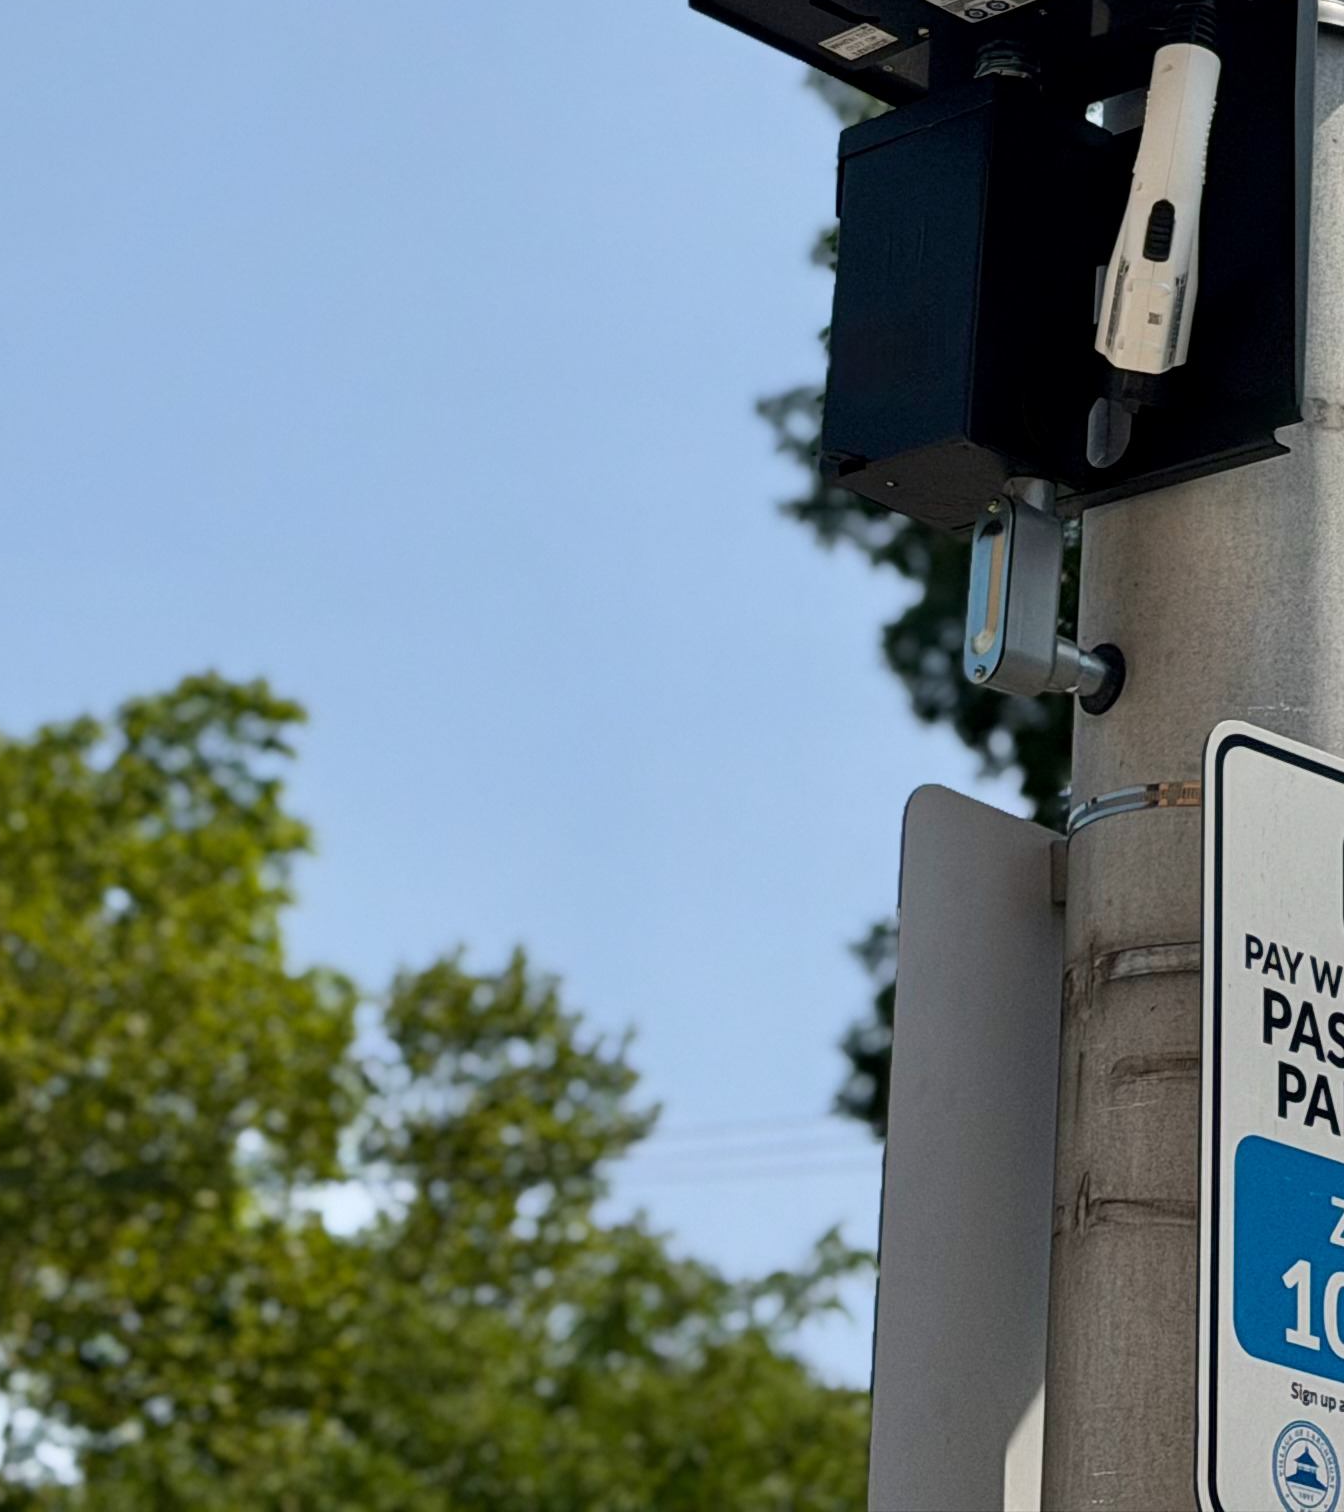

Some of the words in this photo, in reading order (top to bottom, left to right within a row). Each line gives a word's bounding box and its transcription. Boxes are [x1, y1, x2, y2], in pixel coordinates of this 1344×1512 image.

[1245, 933, 1304, 984] PAY
[1290, 1381, 1318, 1406] Sign
[1320, 1395, 1336, 1413] up
